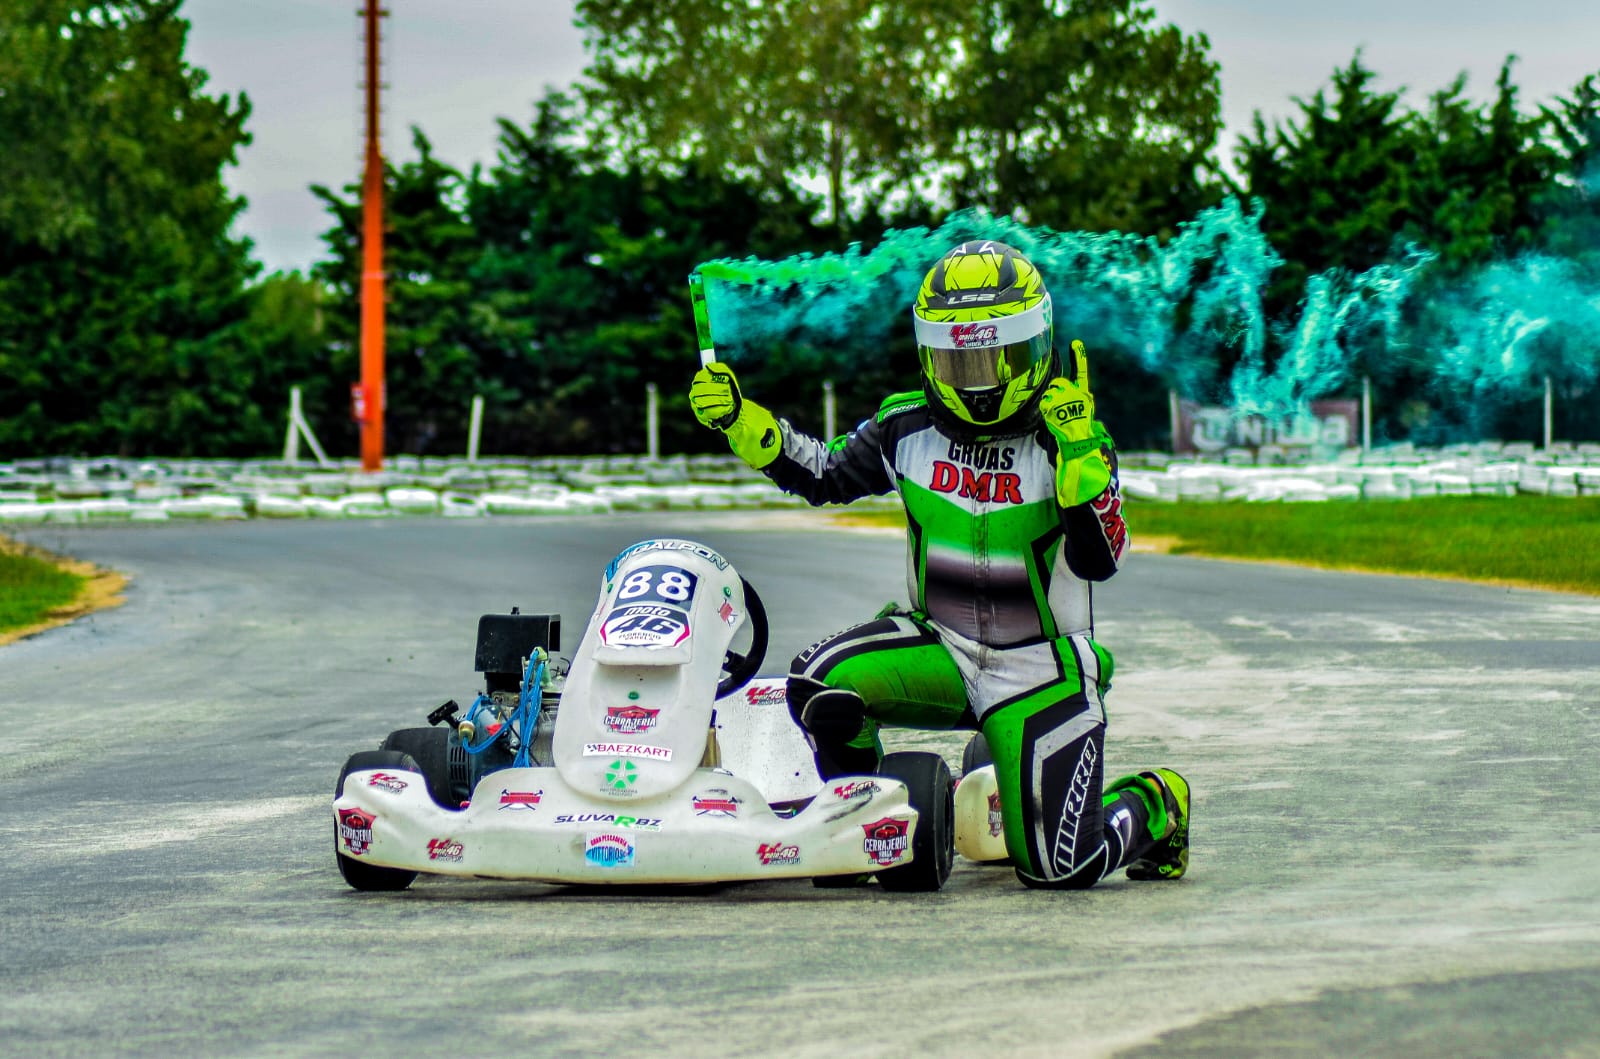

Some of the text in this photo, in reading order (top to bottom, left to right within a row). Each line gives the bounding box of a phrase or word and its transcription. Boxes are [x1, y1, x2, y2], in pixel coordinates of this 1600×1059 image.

[947, 293, 996, 305] LS2
[975, 327, 994, 340] 46
[1056, 404, 1085, 420] OMP
[948, 443, 1016, 470] GRUAS
[929, 461, 1024, 504] DMR
[619, 571, 692, 601] 88
[624, 606, 671, 617] moto
[609, 615, 681, 635] 46
[597, 744, 671, 758] BAEZKART
[864, 835, 908, 853] CERRAJERIA
[779, 847, 798, 859] 46
